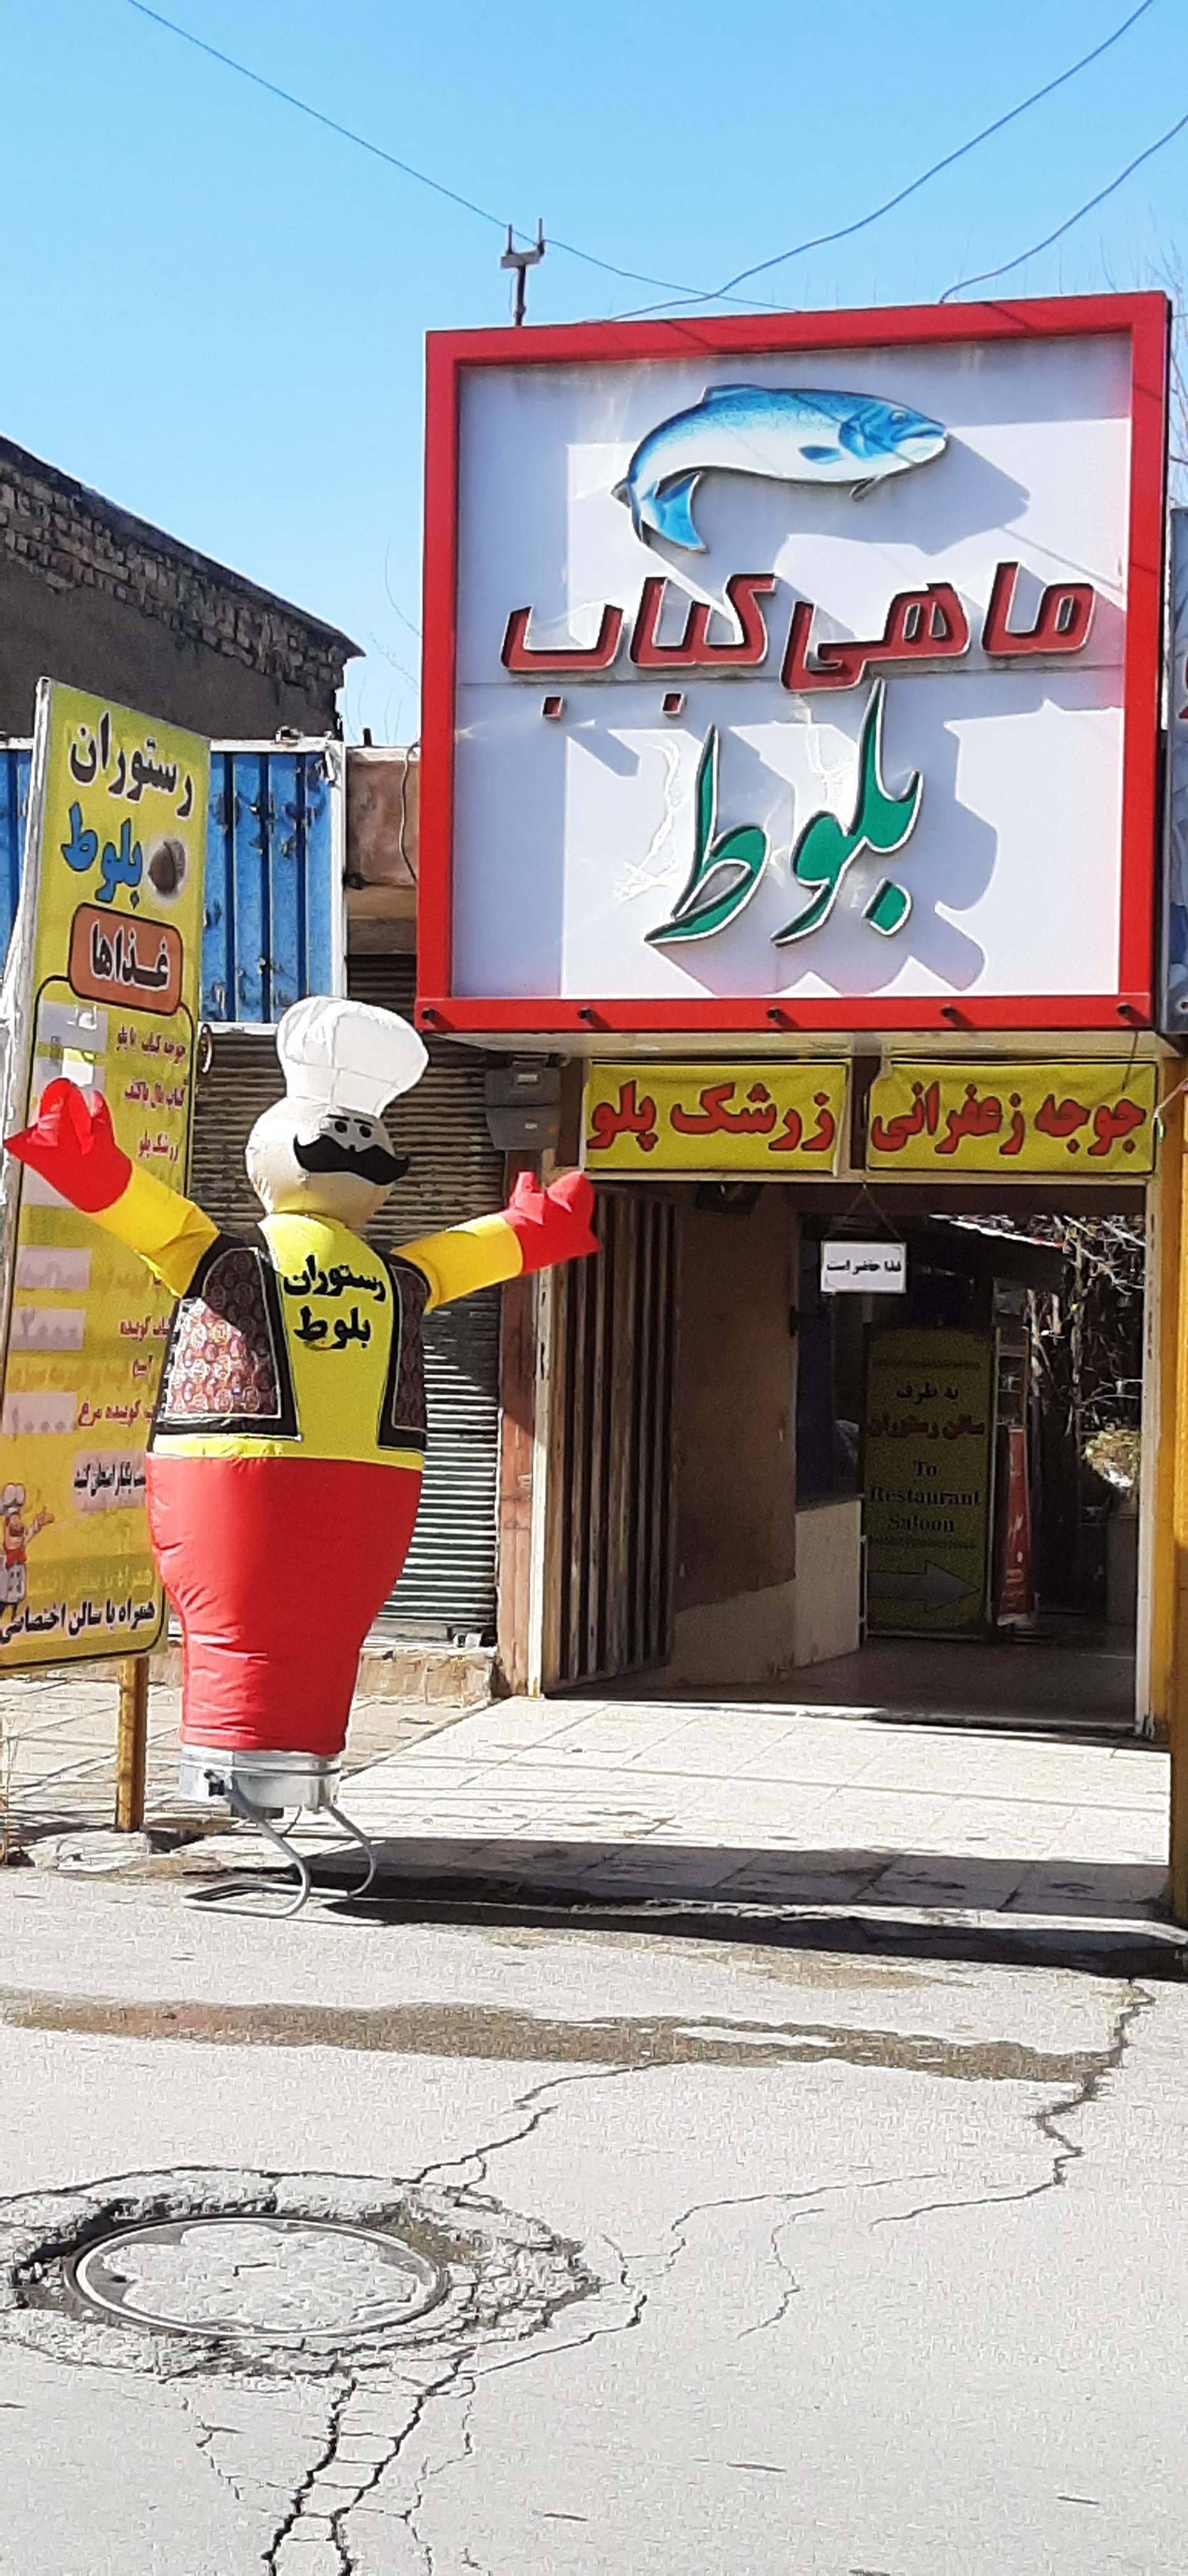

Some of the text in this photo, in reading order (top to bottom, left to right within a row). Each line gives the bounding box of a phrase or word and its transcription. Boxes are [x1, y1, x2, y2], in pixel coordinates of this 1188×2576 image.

[500, 570, 779, 719] کباب
[779, 560, 1095, 692] ماهی
[69, 710, 194, 820] رستوران
[644, 678, 924, 947] بلوط
[61, 801, 143, 910] بلوط
[91, 919, 171, 992] غذاها
[587, 1079, 835, 1152] زرشک پلو
[870, 1081, 1147, 1156] جوجه زعفرانی
[283, 1254, 386, 1303] رستوران
[293, 1305, 372, 1350] بلوط
[869, 1486, 981, 1506] Restaurant
[913, 1460, 938, 1478] To
[888, 1515, 956, 1533] Saloon
